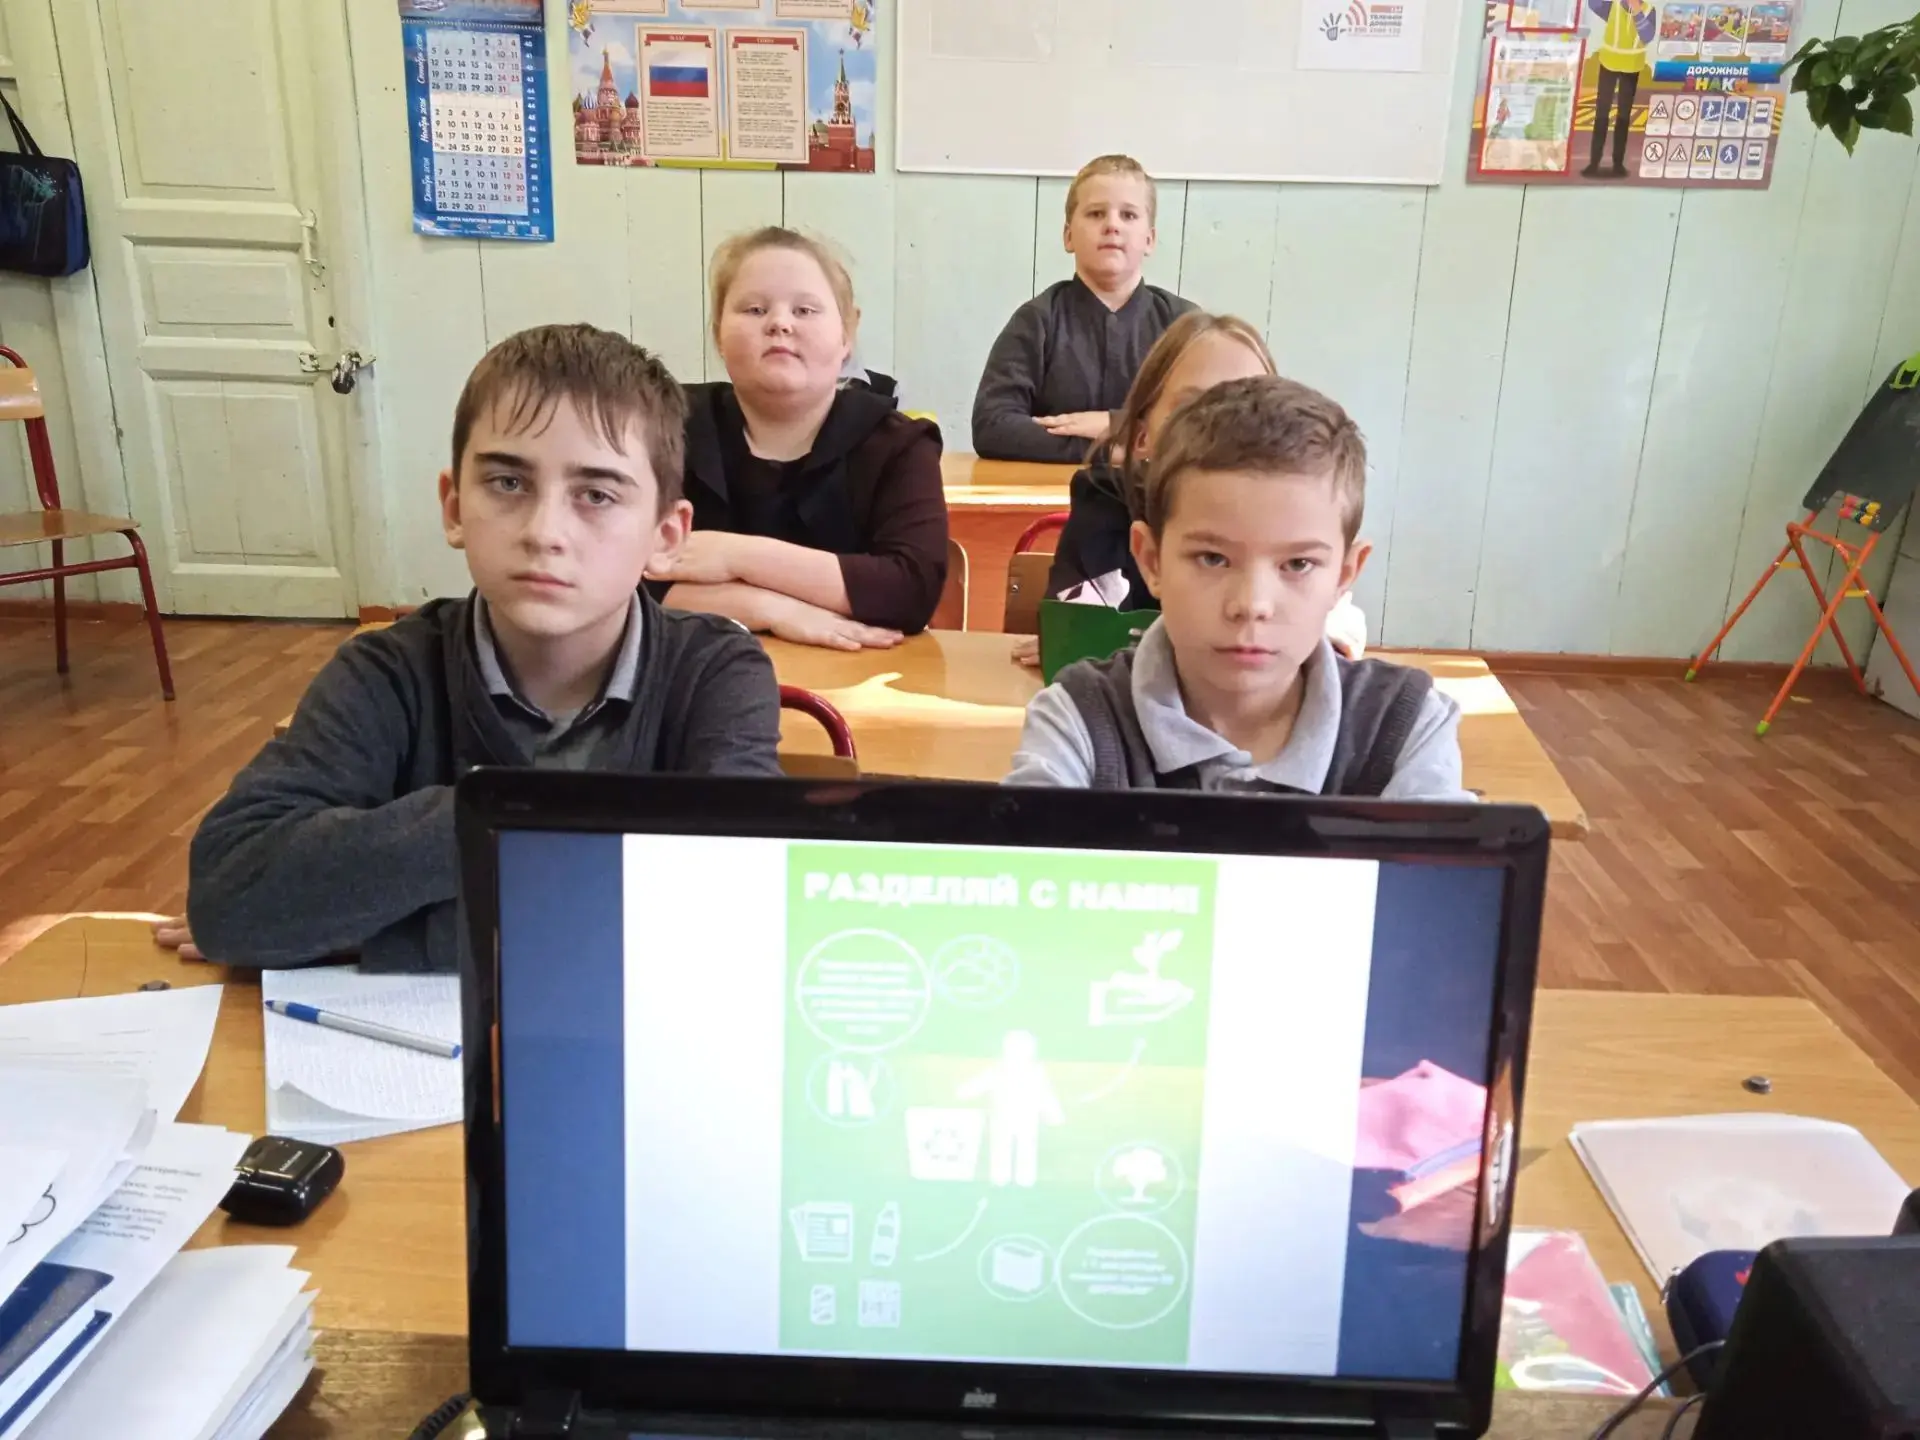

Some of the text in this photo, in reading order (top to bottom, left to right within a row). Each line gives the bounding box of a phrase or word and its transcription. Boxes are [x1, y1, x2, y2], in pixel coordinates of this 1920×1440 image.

[497, 50, 506, 58] 10
[510, 51, 519, 59] 11
[430, 59, 440, 67] 12
[444, 59, 453, 67] 13
[457, 60, 466, 68] 14
[470, 61, 479, 69] 15
[484, 62, 493, 70] 16
[497, 62, 506, 71] 17
[1686, 66, 1749, 76] ДОРОЖНЫЕ
[431, 70, 440, 78] 19
[444, 70, 453, 79] 20
[457, 71, 466, 80] 21
[471, 72, 480, 81] 22
[484, 73, 493, 82] 23
[497, 74, 507, 82] 24
[511, 74, 520, 82] 25
[431, 82, 441, 90] 26
[444, 82, 454, 91] 27
[458, 83, 467, 91] 28
[471, 83, 481, 92] 29
[485, 84, 494, 93] 30
[498, 85, 507, 93] 31
[1682, 76, 1748, 92] ЗНАКИ
[447, 120, 457, 129] 10
[460, 121, 469, 129] 11
[474, 121, 483, 130] 12
[487, 122, 496, 131] 13
[500, 123, 509, 131] 14
[513, 124, 523, 132] 15
[435, 131, 444, 139] 16
[448, 131, 457, 140] 17
[474, 133, 483, 141] 19
[487, 133, 496, 142] 20
[500, 134, 509, 142] 21
[513, 135, 523, 143] 22
[448, 143, 457, 152] 24
[461, 144, 470, 152] 25
[475, 144, 484, 153] 26
[487, 145, 497, 153] 27
[501, 145, 510, 154] 28
[514, 146, 523, 155] 29
[477, 170, 486, 178] 10
[489, 171, 498, 179] 11
[502, 172, 512, 180] 12
[516, 172, 525, 180] 13
[437, 179, 447, 187] 14
[450, 180, 460, 188] 15
[464, 180, 473, 189] 16
[477, 181, 486, 189] 17
[503, 182, 512, 191] 19
[516, 184, 525, 192] 20
[437, 190, 447, 198] 21
[451, 191, 460, 199] 22
[464, 192, 473, 200] 23
[477, 192, 486, 201] 24
[490, 193, 499, 202] 25
[503, 194, 512, 202] 26
[516, 195, 525, 203] 27
[439, 201, 448, 209] 28
[452, 202, 461, 210] 29
[465, 203, 474, 211] 30
[477, 203, 487, 212] 31
[803, 872, 1019, 907] РАЗДЕЛЯЙ
[1029, 879, 1058, 908] С
